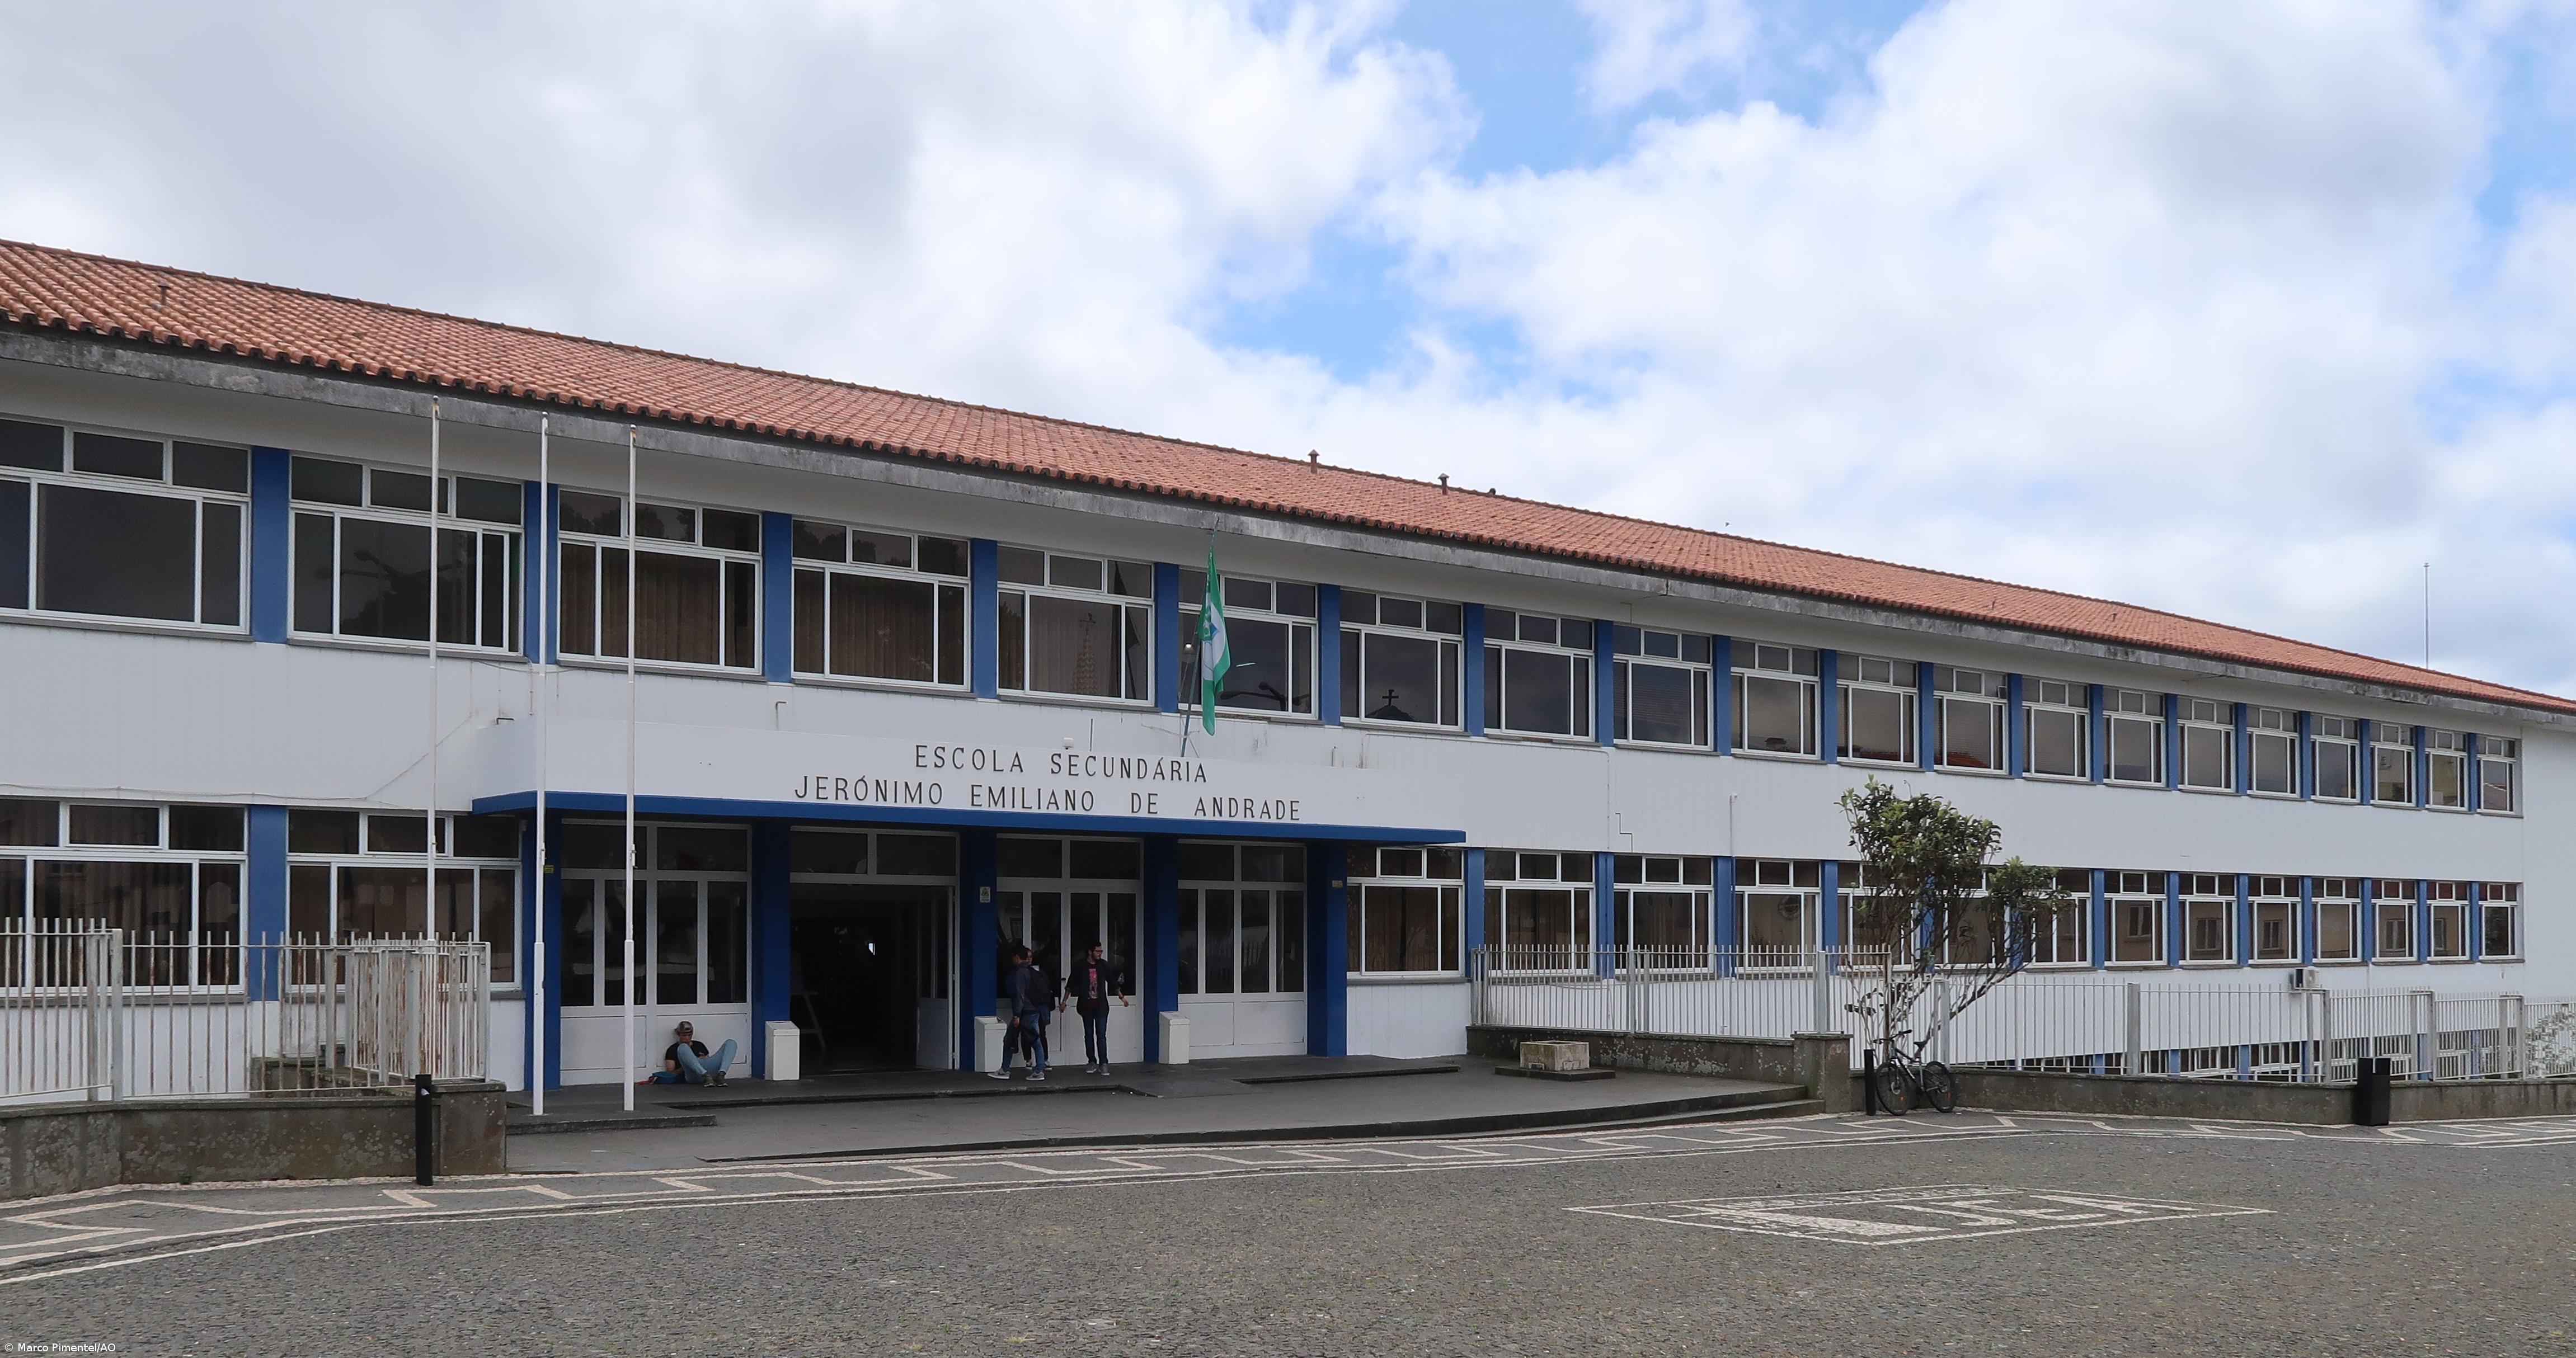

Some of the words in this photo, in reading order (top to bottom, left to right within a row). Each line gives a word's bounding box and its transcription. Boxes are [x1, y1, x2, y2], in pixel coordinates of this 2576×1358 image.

[915, 744, 1024, 773] ESCOLA
[1051, 753, 1207, 783] SECUNDÁRIA
[795, 775, 943, 805] JERÓNIMO
[971, 784, 1094, 812] EMILIANO
[1131, 792, 1158, 814] DE
[1194, 796, 1300, 821] ANDRADE
